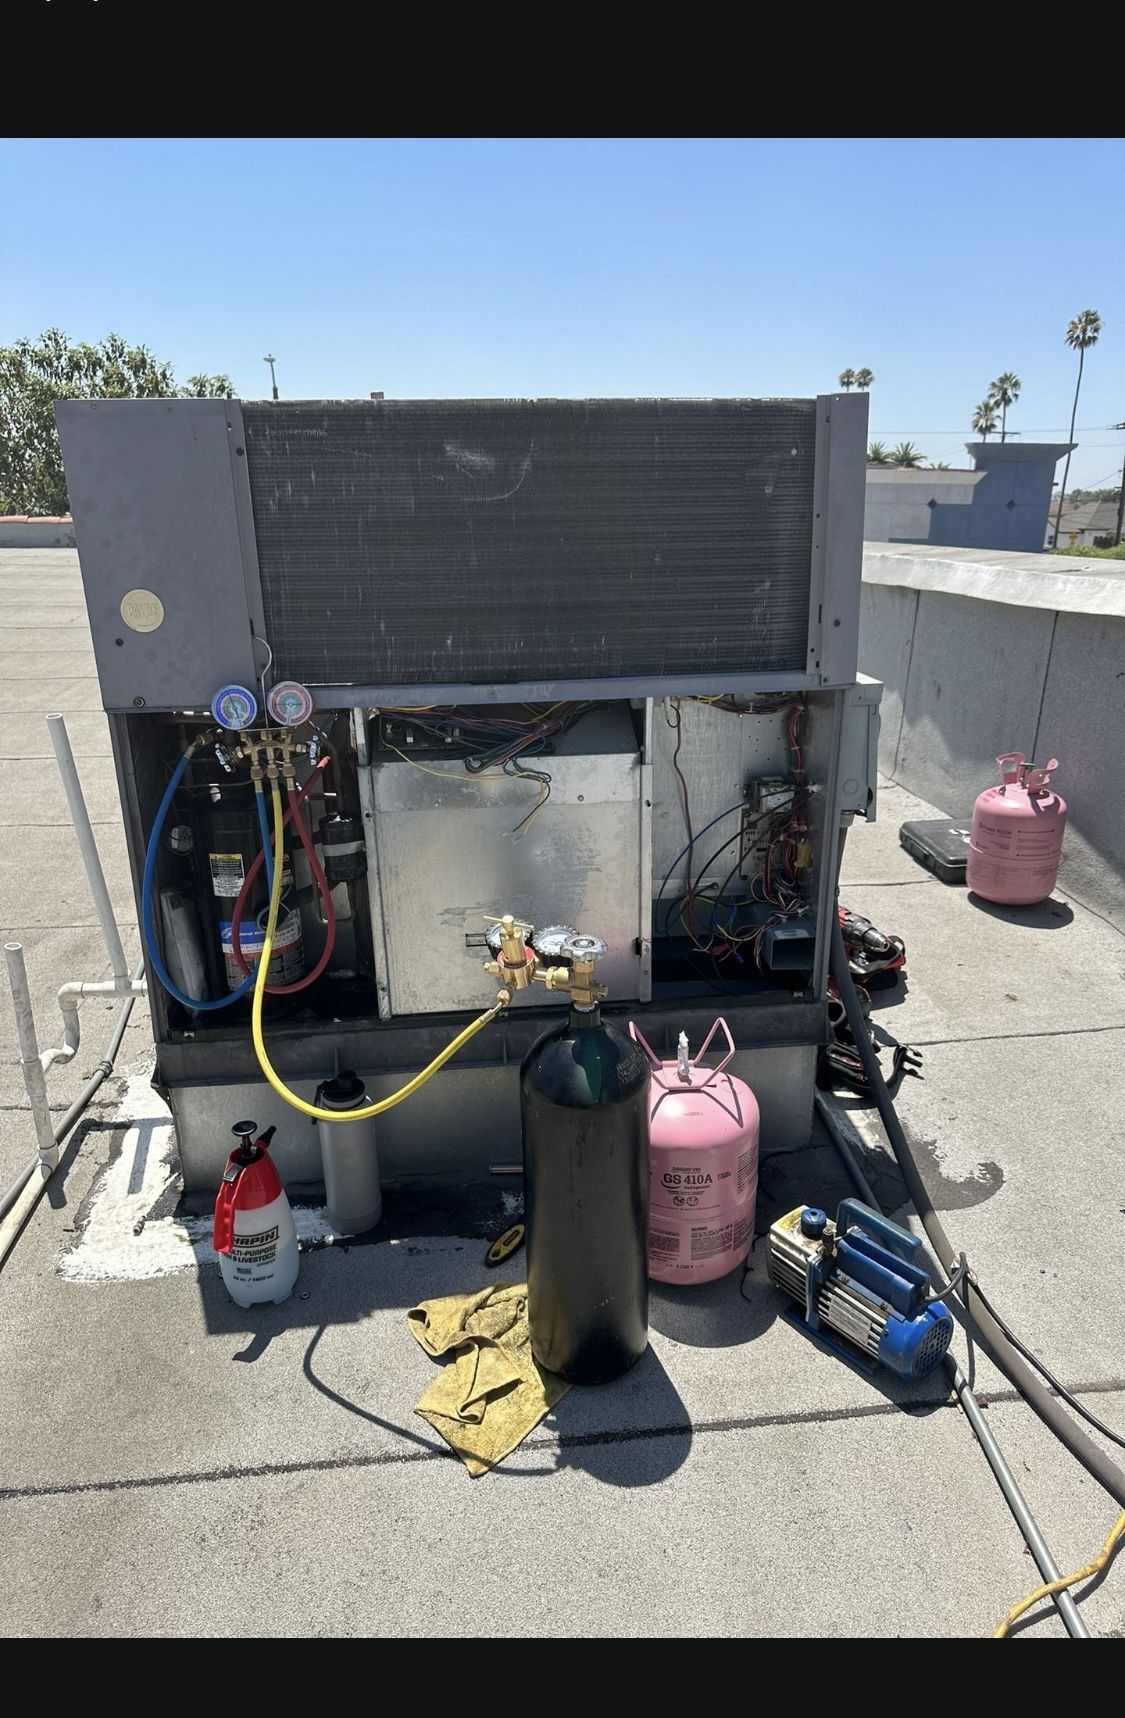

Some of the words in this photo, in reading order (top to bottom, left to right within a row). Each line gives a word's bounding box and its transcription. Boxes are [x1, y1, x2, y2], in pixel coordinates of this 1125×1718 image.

[663, 1173, 682, 1185] GS
[683, 1173, 713, 1185] 410A
[233, 1231, 275, 1245] HAPIN
[230, 1243, 277, 1257] ULTI-PURPOSE
[238, 1251, 276, 1263] LIVESTOCK
